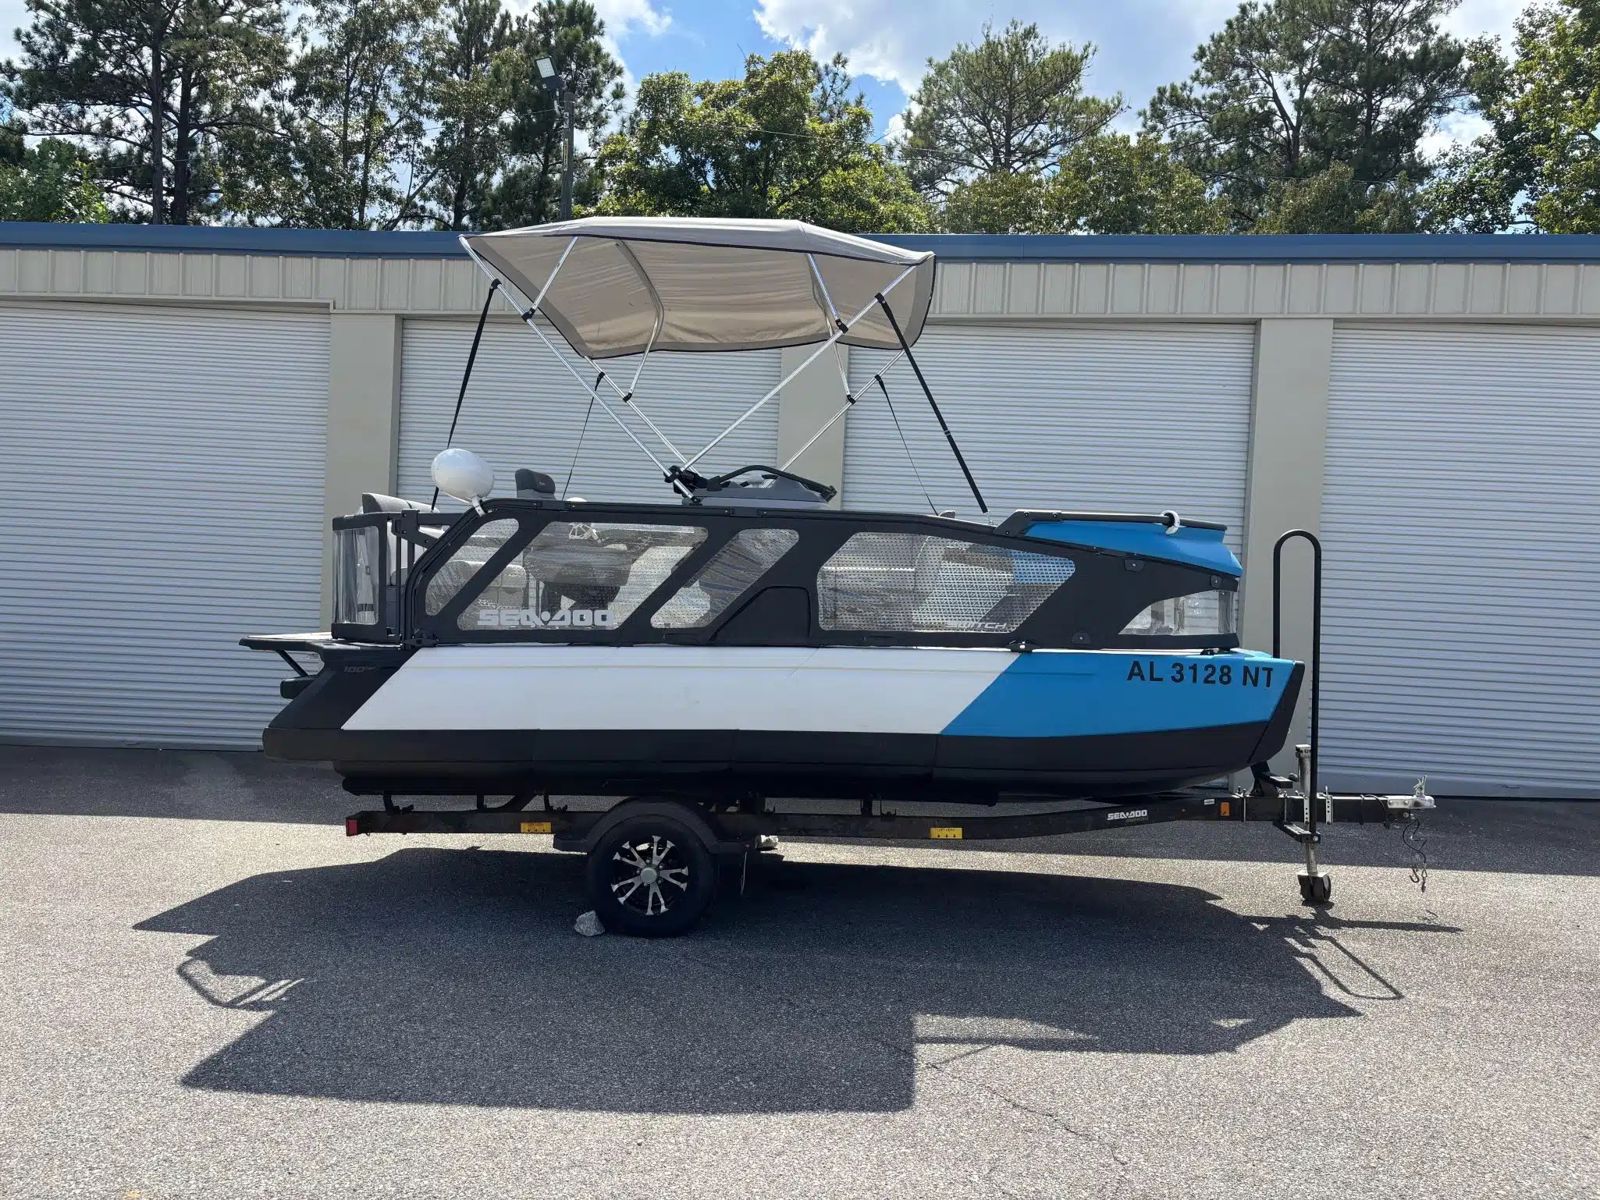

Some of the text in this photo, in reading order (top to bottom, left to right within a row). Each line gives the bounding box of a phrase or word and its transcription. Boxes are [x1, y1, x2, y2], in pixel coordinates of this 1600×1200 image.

[1127, 660, 1274, 688] AL 3128 NT
